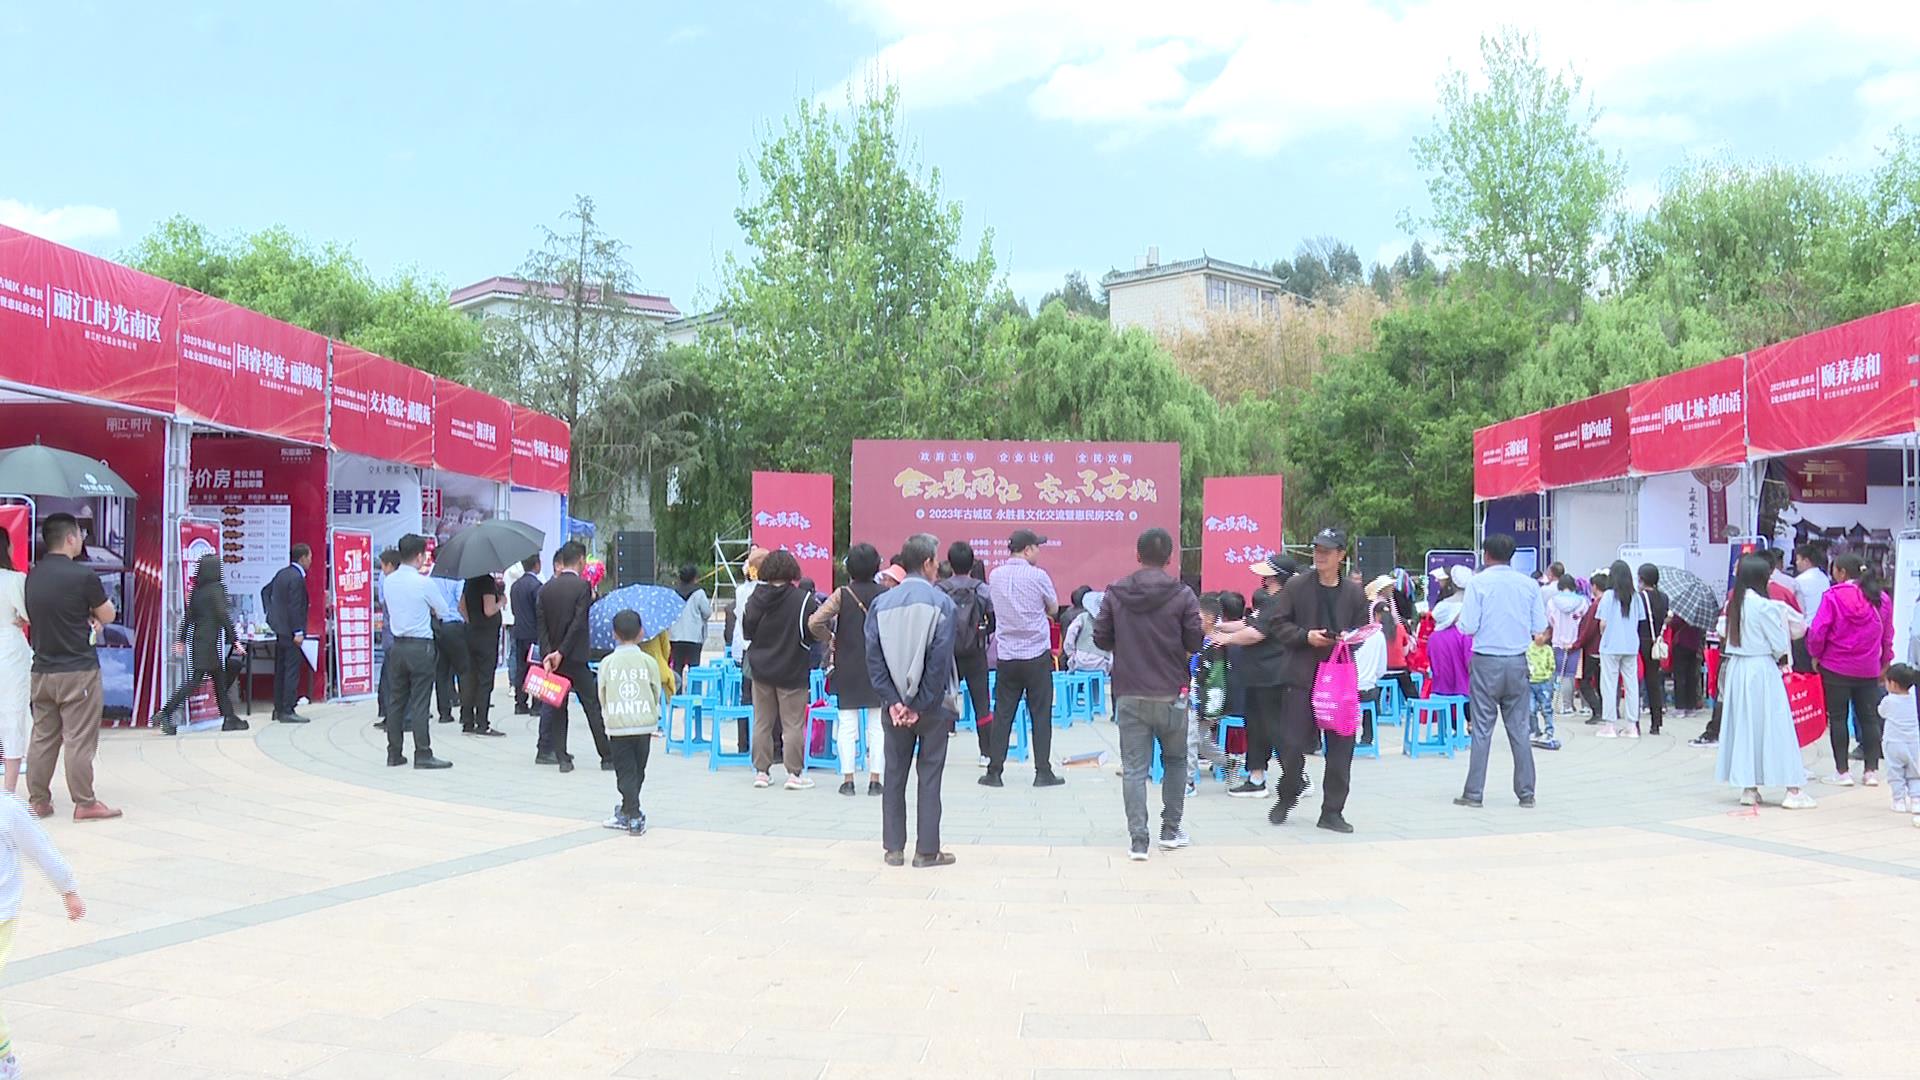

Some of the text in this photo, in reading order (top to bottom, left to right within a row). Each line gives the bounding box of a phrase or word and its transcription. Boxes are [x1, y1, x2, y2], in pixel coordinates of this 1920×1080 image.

[53, 286, 162, 343] 丽江时光南区
[1821, 352, 1881, 388] 颐养泰和
[920, 451, 976, 462] 政府主导
[998, 451, 1054, 462] 企业让利
[1034, 466, 1158, 503] 忘不了的古城
[928, 507, 1125, 521] 2023年古城区 永胜县文化交流暨惠民房交会
[610, 668, 649, 680] FASH
